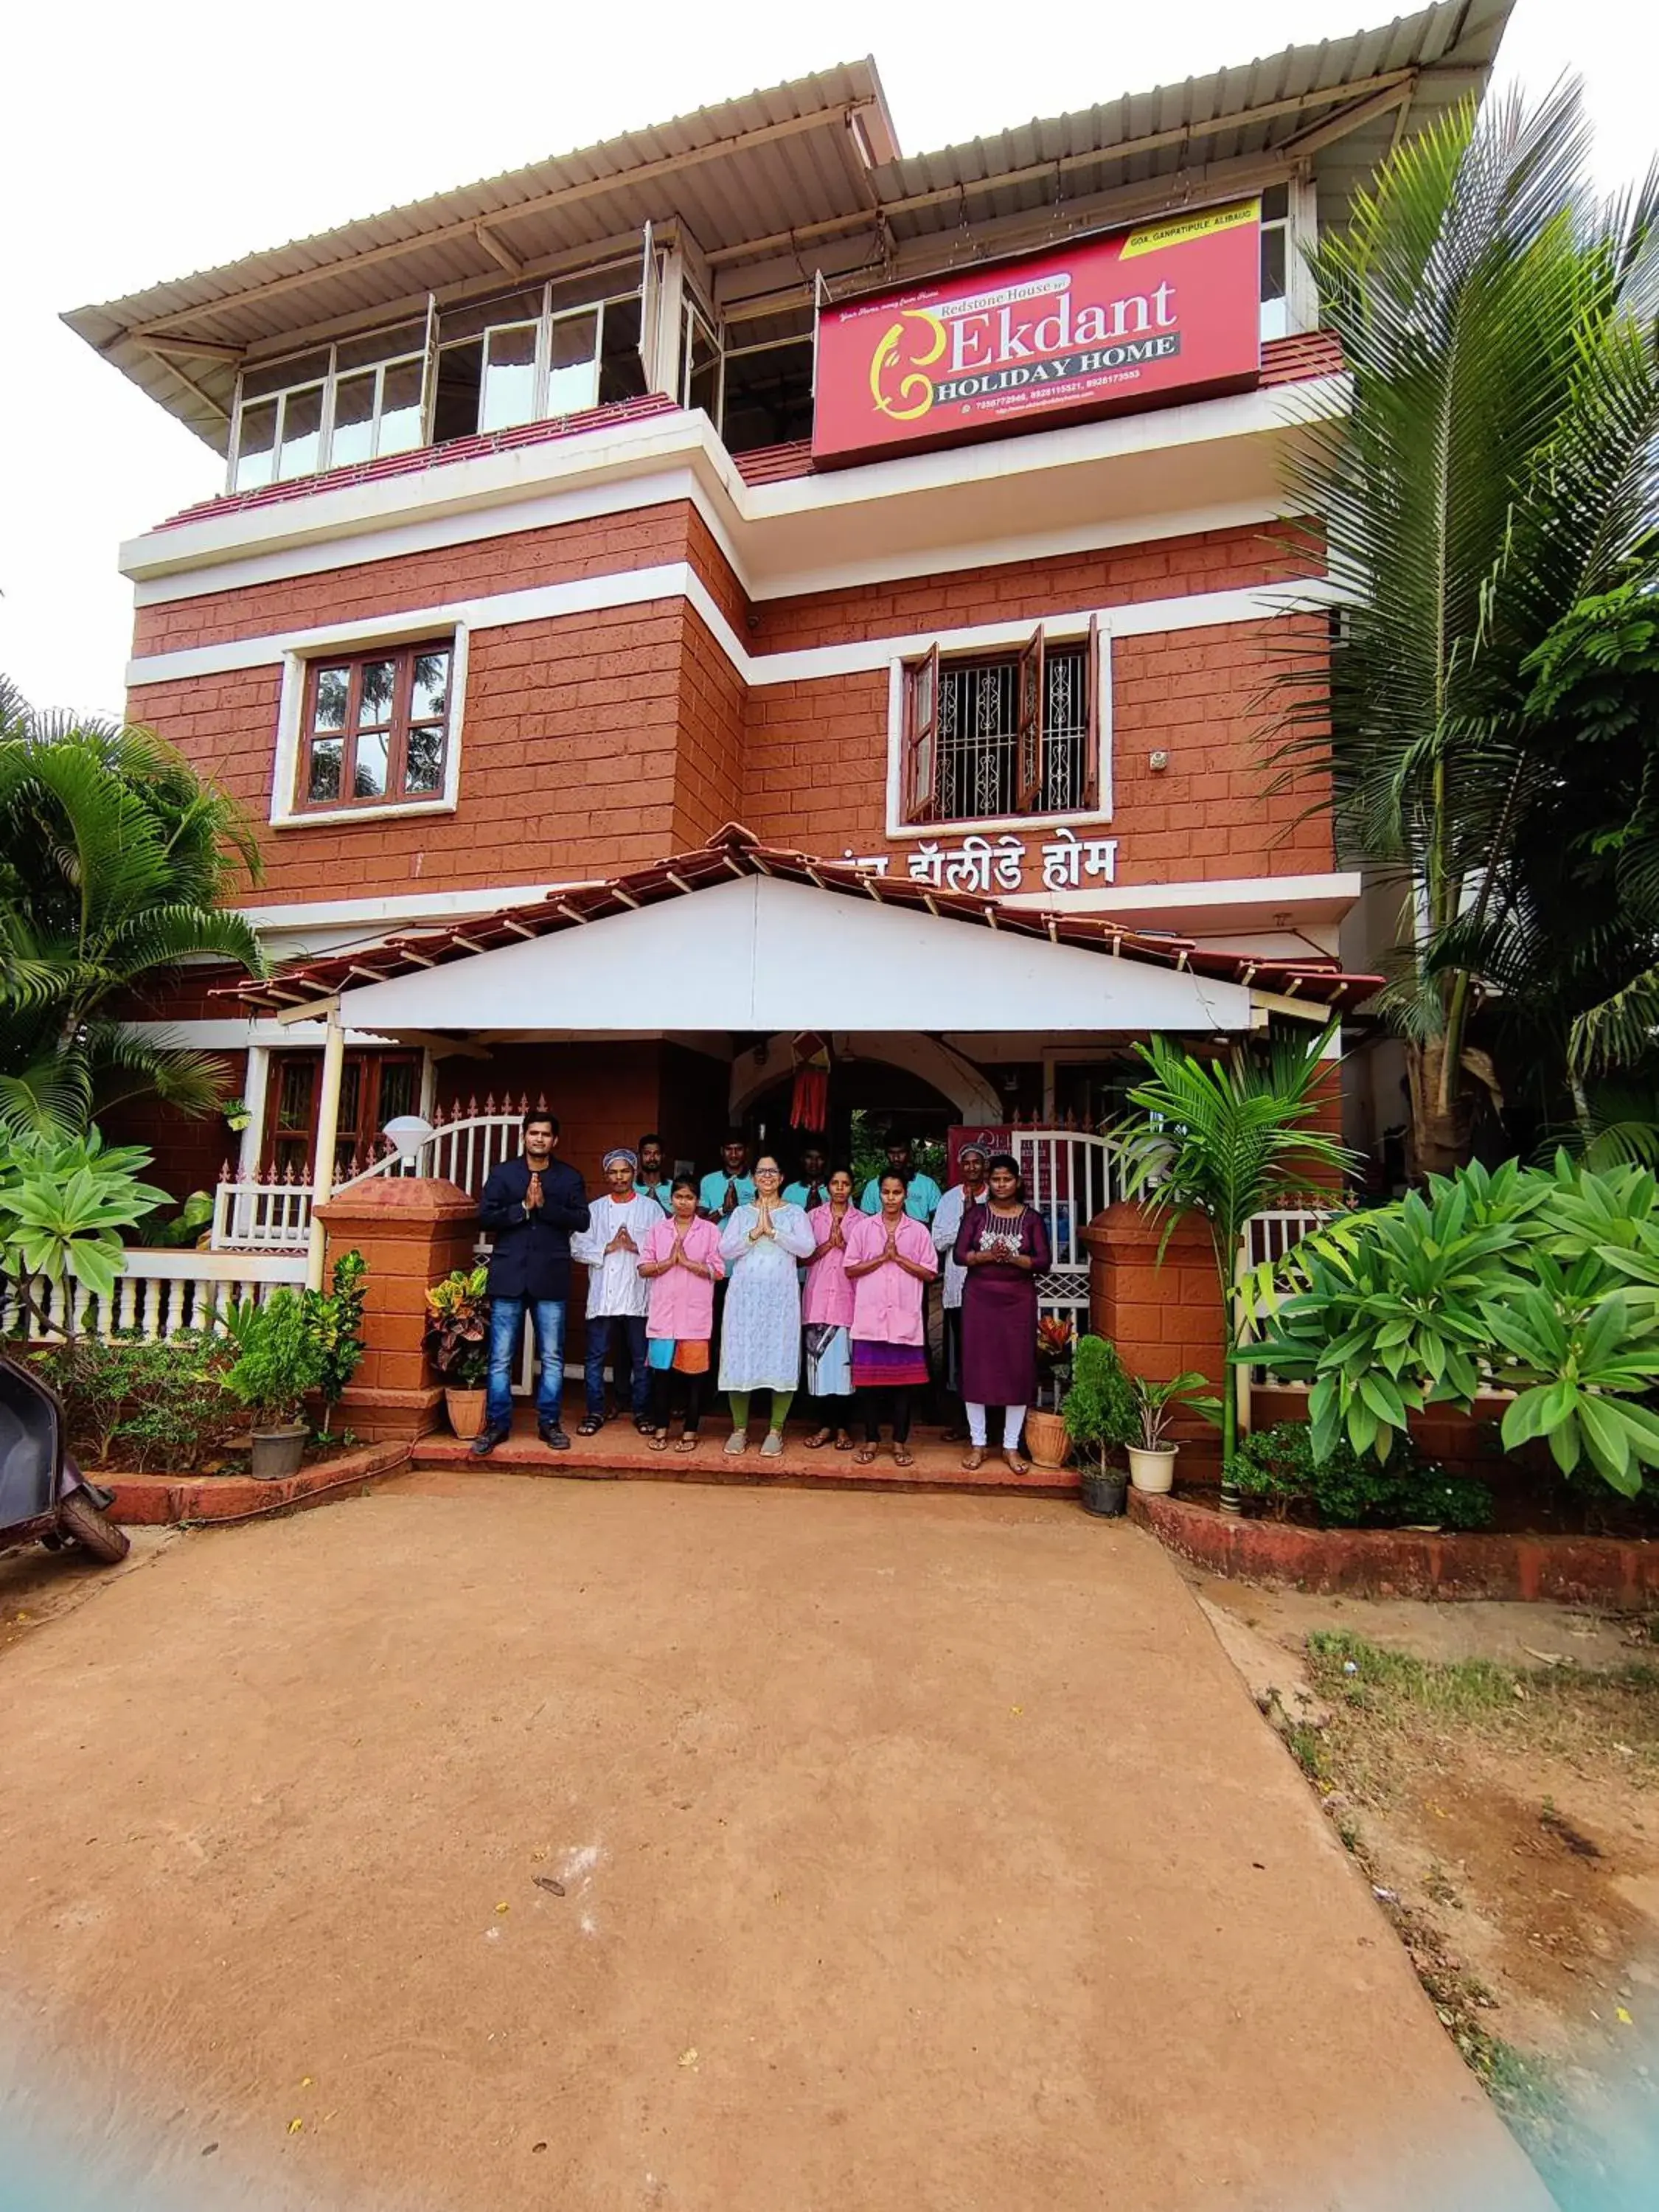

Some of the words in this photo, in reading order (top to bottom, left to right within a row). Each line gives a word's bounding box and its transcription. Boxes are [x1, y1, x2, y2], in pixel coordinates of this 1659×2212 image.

[941, 293, 1004, 317] Redstone
[1007, 282, 1051, 302] House
[947, 280, 1178, 373] Ekdant
[937, 359, 1071, 403] HOLIDAY
[1079, 336, 1175, 372] HOME
[1043, 827, 1118, 891] होम
